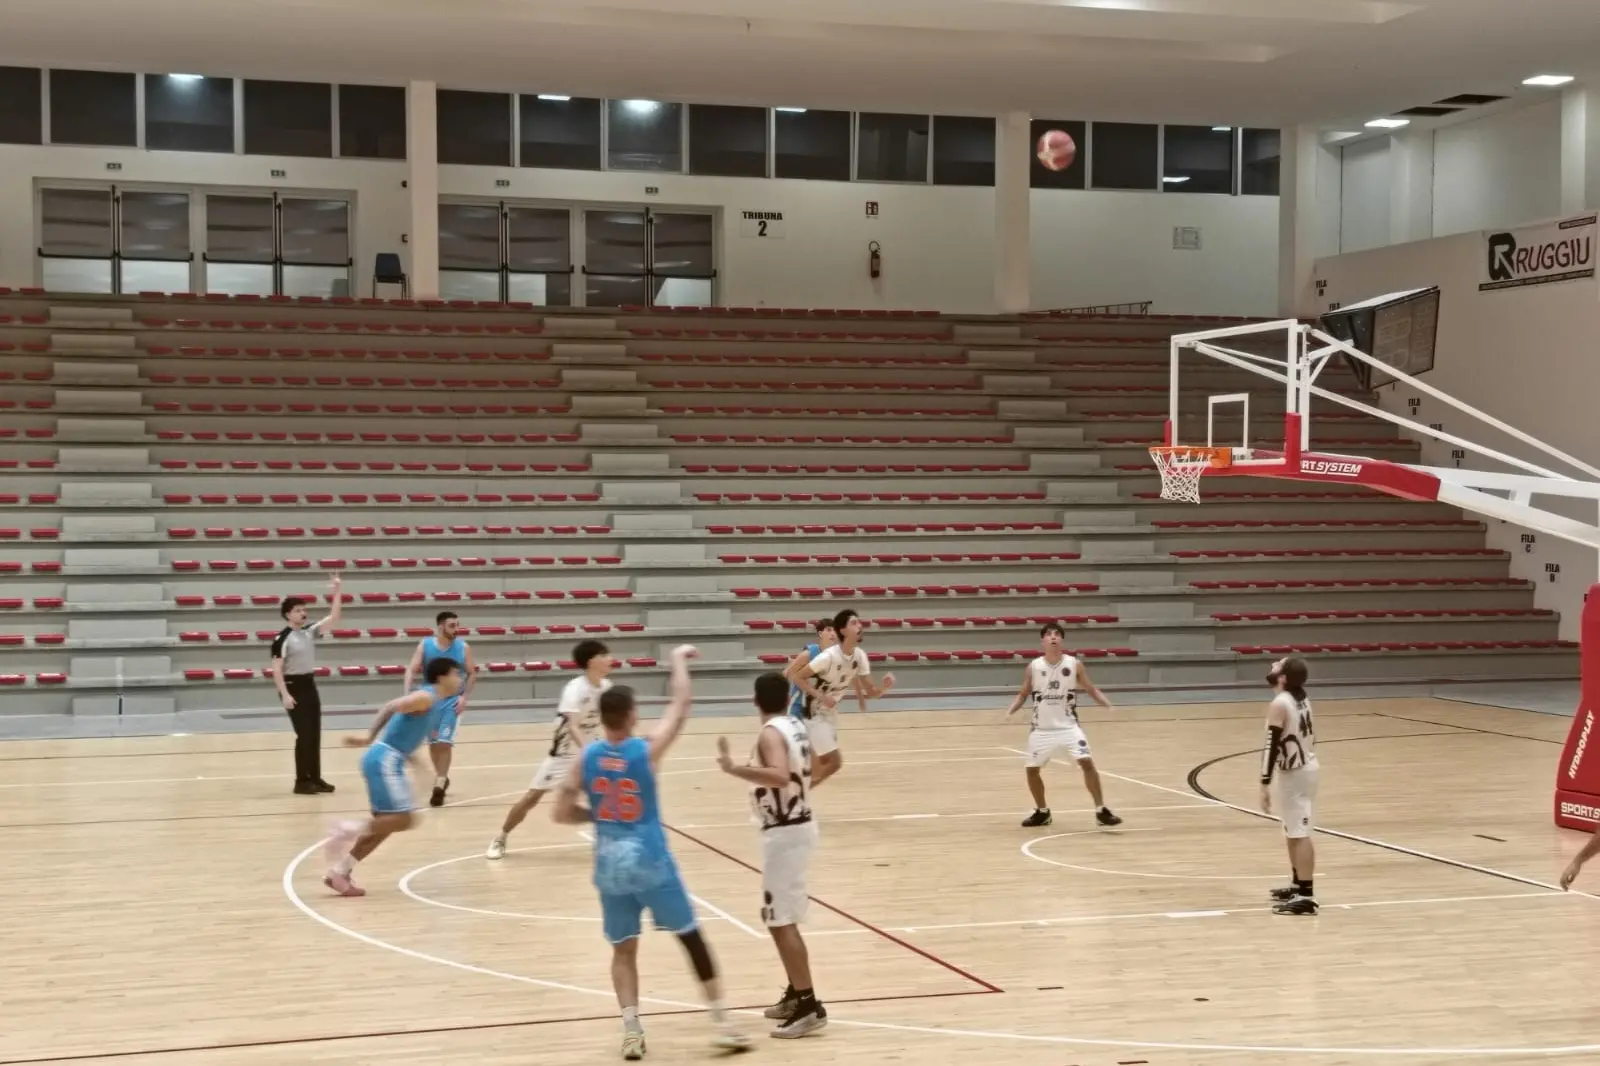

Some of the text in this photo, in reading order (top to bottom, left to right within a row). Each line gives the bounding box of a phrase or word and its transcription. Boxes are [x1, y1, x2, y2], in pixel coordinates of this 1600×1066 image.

[742, 211, 783, 220] TRIBUNA
[758, 220, 767, 237] 2
[1516, 236, 1590, 273] RUGGIU
[1316, 462, 1362, 475] SYSTEM
[1521, 534, 1535, 543] FILA
[1545, 563, 1560, 573] FILA
